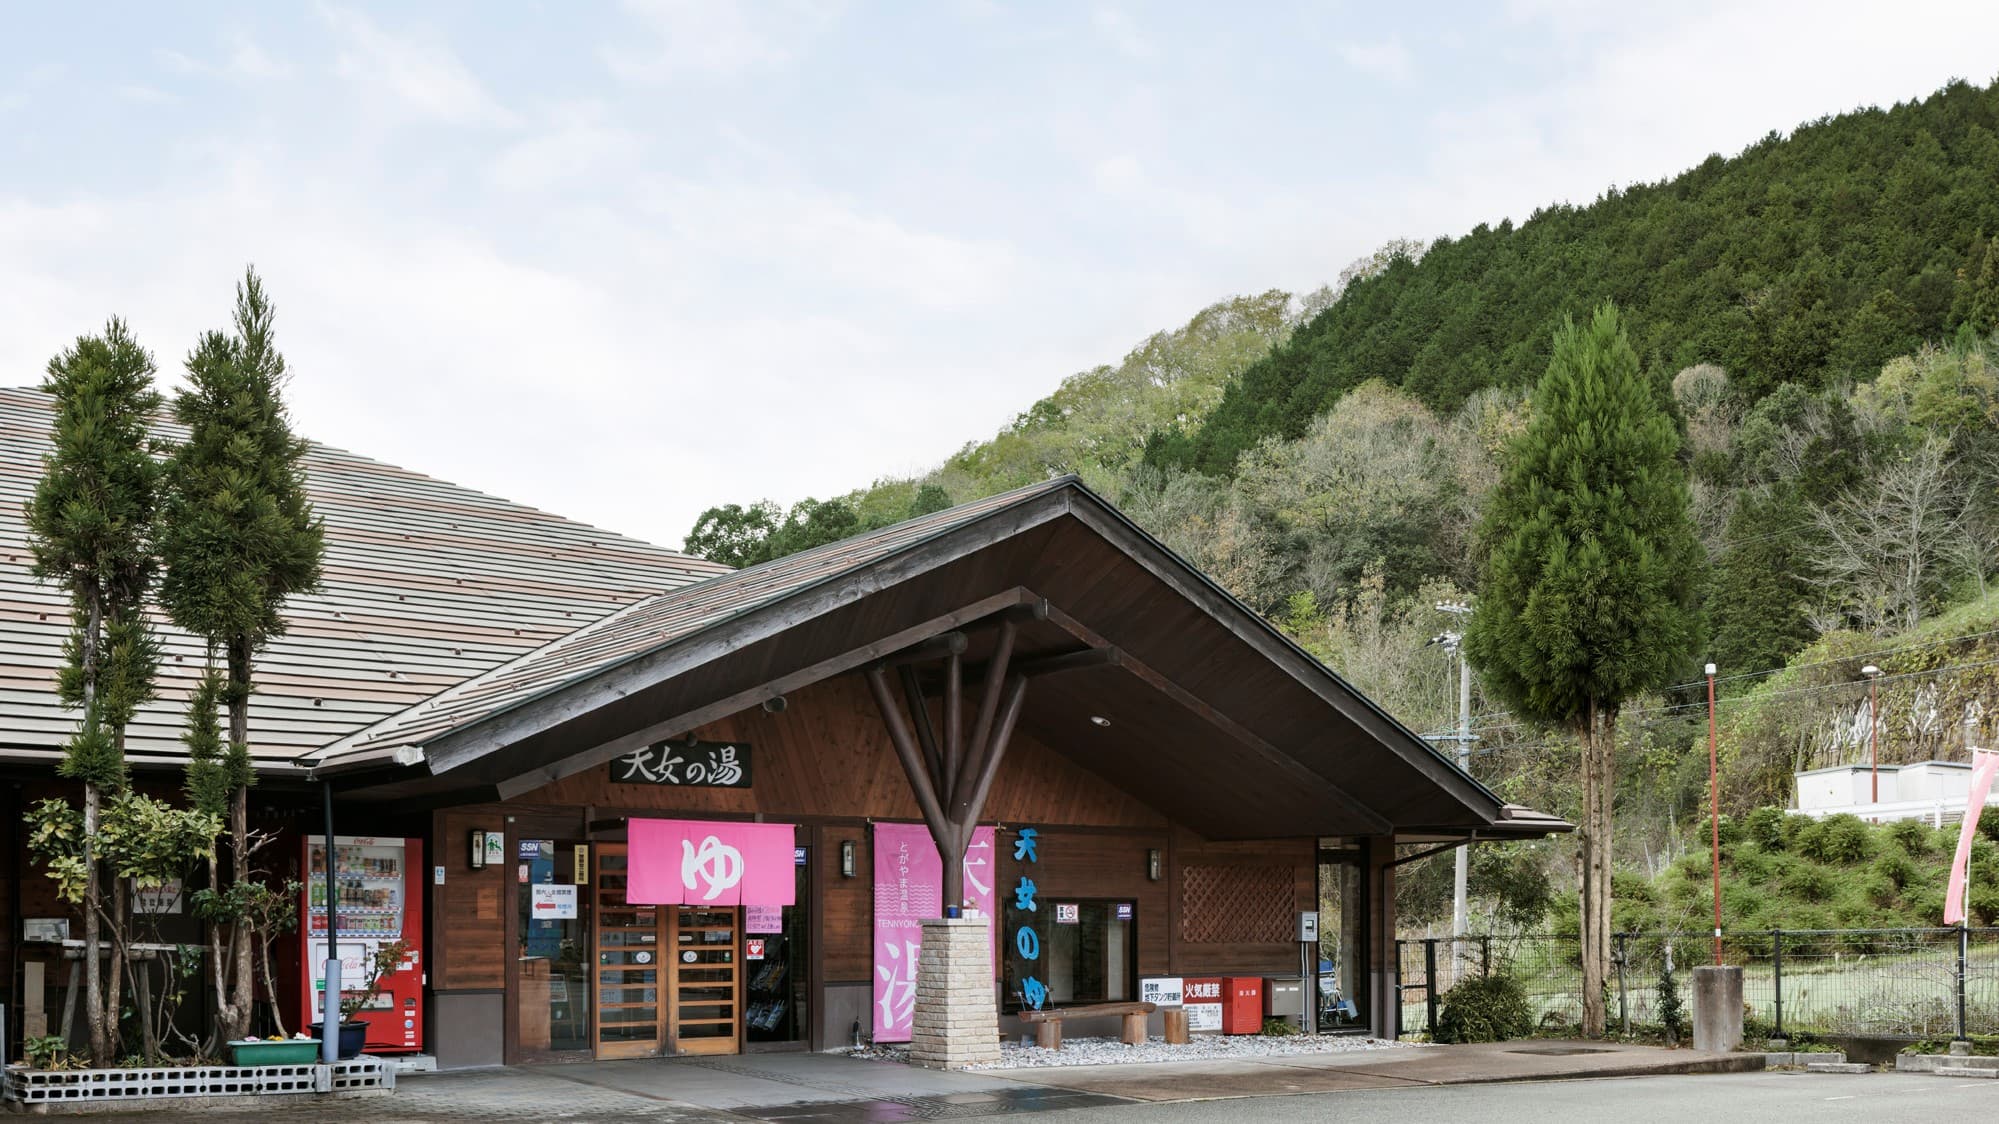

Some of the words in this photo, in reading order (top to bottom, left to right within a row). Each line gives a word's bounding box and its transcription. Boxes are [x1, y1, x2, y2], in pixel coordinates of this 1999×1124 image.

[620, 744, 743, 786] 天女の湯
[519, 842, 539, 852] SSN
[794, 849, 805, 858] SN
[681, 835, 745, 900] ゆ
[1185, 982, 1221, 999] 火気厳禁
